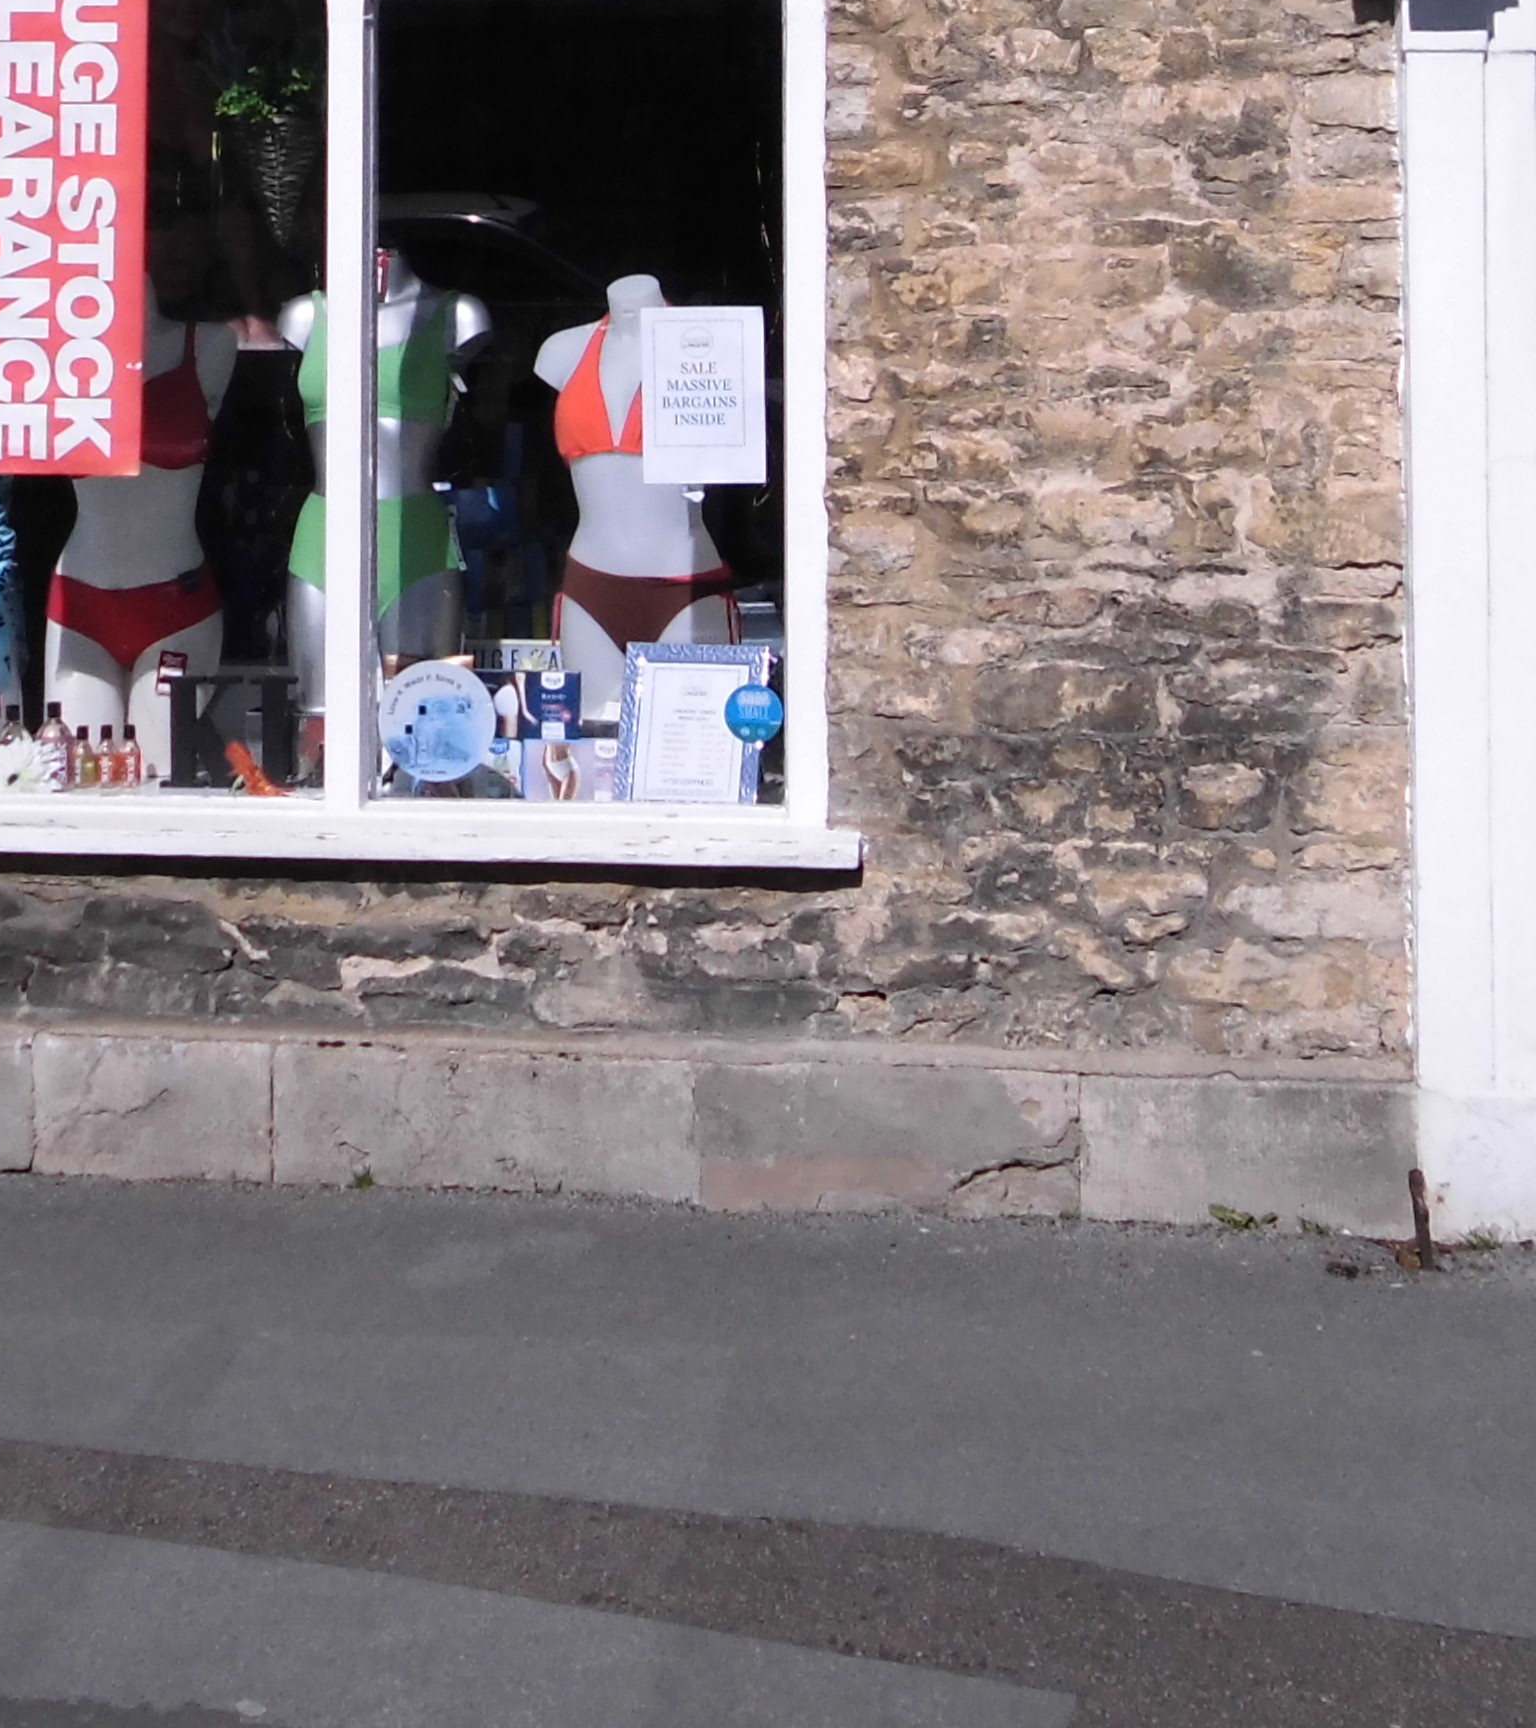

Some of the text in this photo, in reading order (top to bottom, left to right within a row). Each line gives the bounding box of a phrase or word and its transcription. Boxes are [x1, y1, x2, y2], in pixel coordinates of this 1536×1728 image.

[54, 174, 117, 462] STOCK
[680, 361, 718, 374] SALE
[666, 379, 732, 392] MASSIVE
[662, 396, 737, 409] BARGAINS
[674, 413, 726, 426] INSIDE
